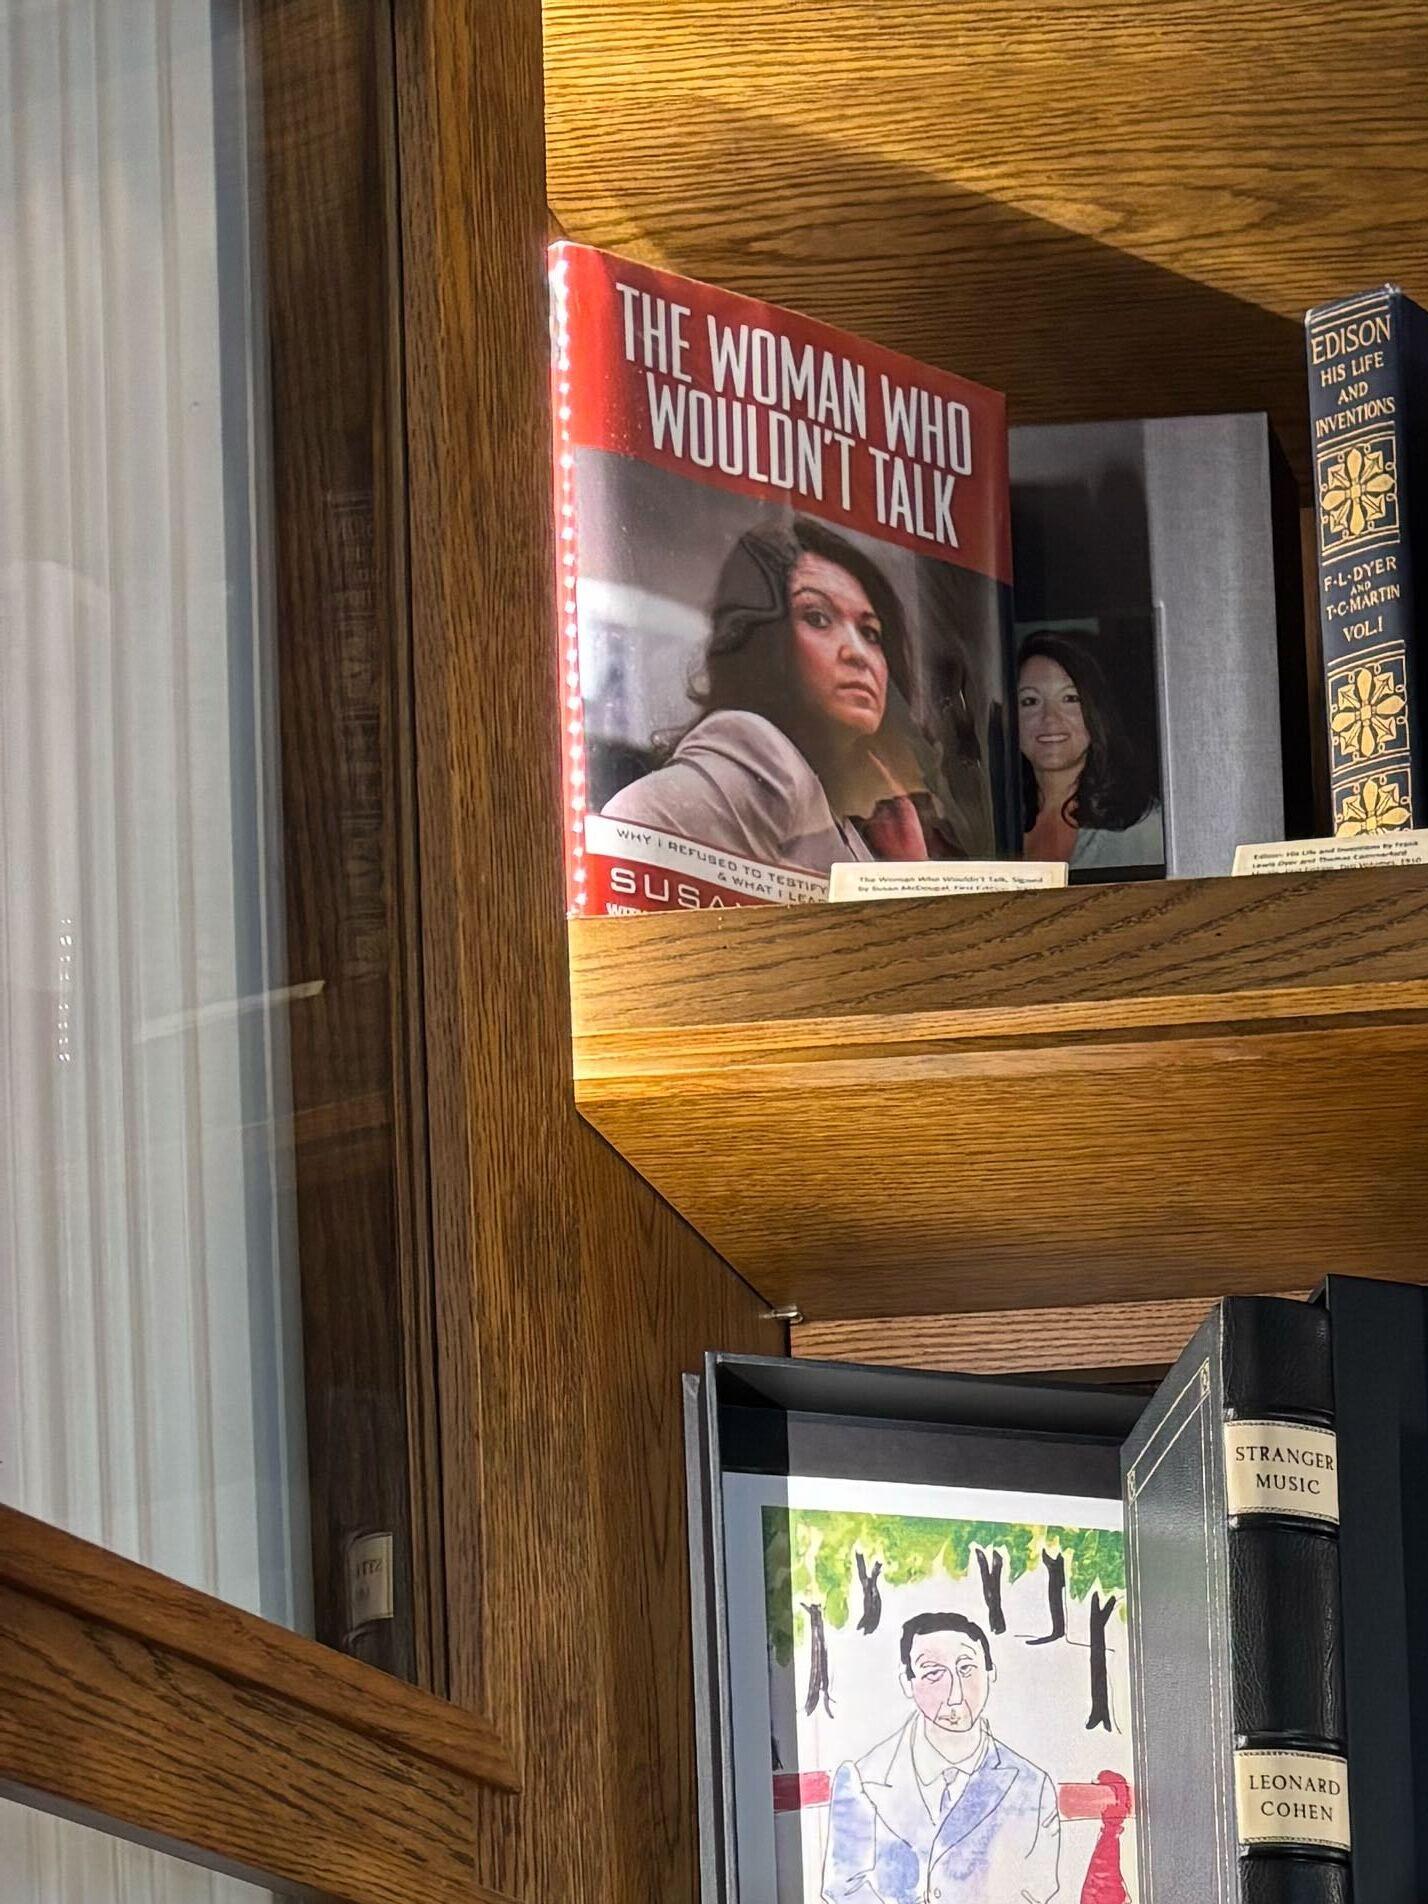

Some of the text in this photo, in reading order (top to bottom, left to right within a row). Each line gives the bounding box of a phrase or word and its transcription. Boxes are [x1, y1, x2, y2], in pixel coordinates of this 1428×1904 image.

[1310, 315, 1391, 364] EDISON
[615, 283, 972, 475] THE WOMAN WHO
[1320, 351, 1384, 383] HIS LIFE
[1337, 381, 1368, 405] AND
[1315, 397, 1395, 437] INVENTIONS
[646, 373, 960, 548] WOULDN'T TALK
[617, 827, 653, 844] WHY
[668, 841, 738, 872] REFUSED
[742, 863, 761, 879] TO
[767, 868, 828, 895] TESTIFY
[1234, 1444, 1335, 1472] STRANGER
[1255, 1472, 1321, 1496] MUSIC
[1248, 1774, 1341, 1797] LEONARD
[1260, 1799, 1333, 1823] COHEN
